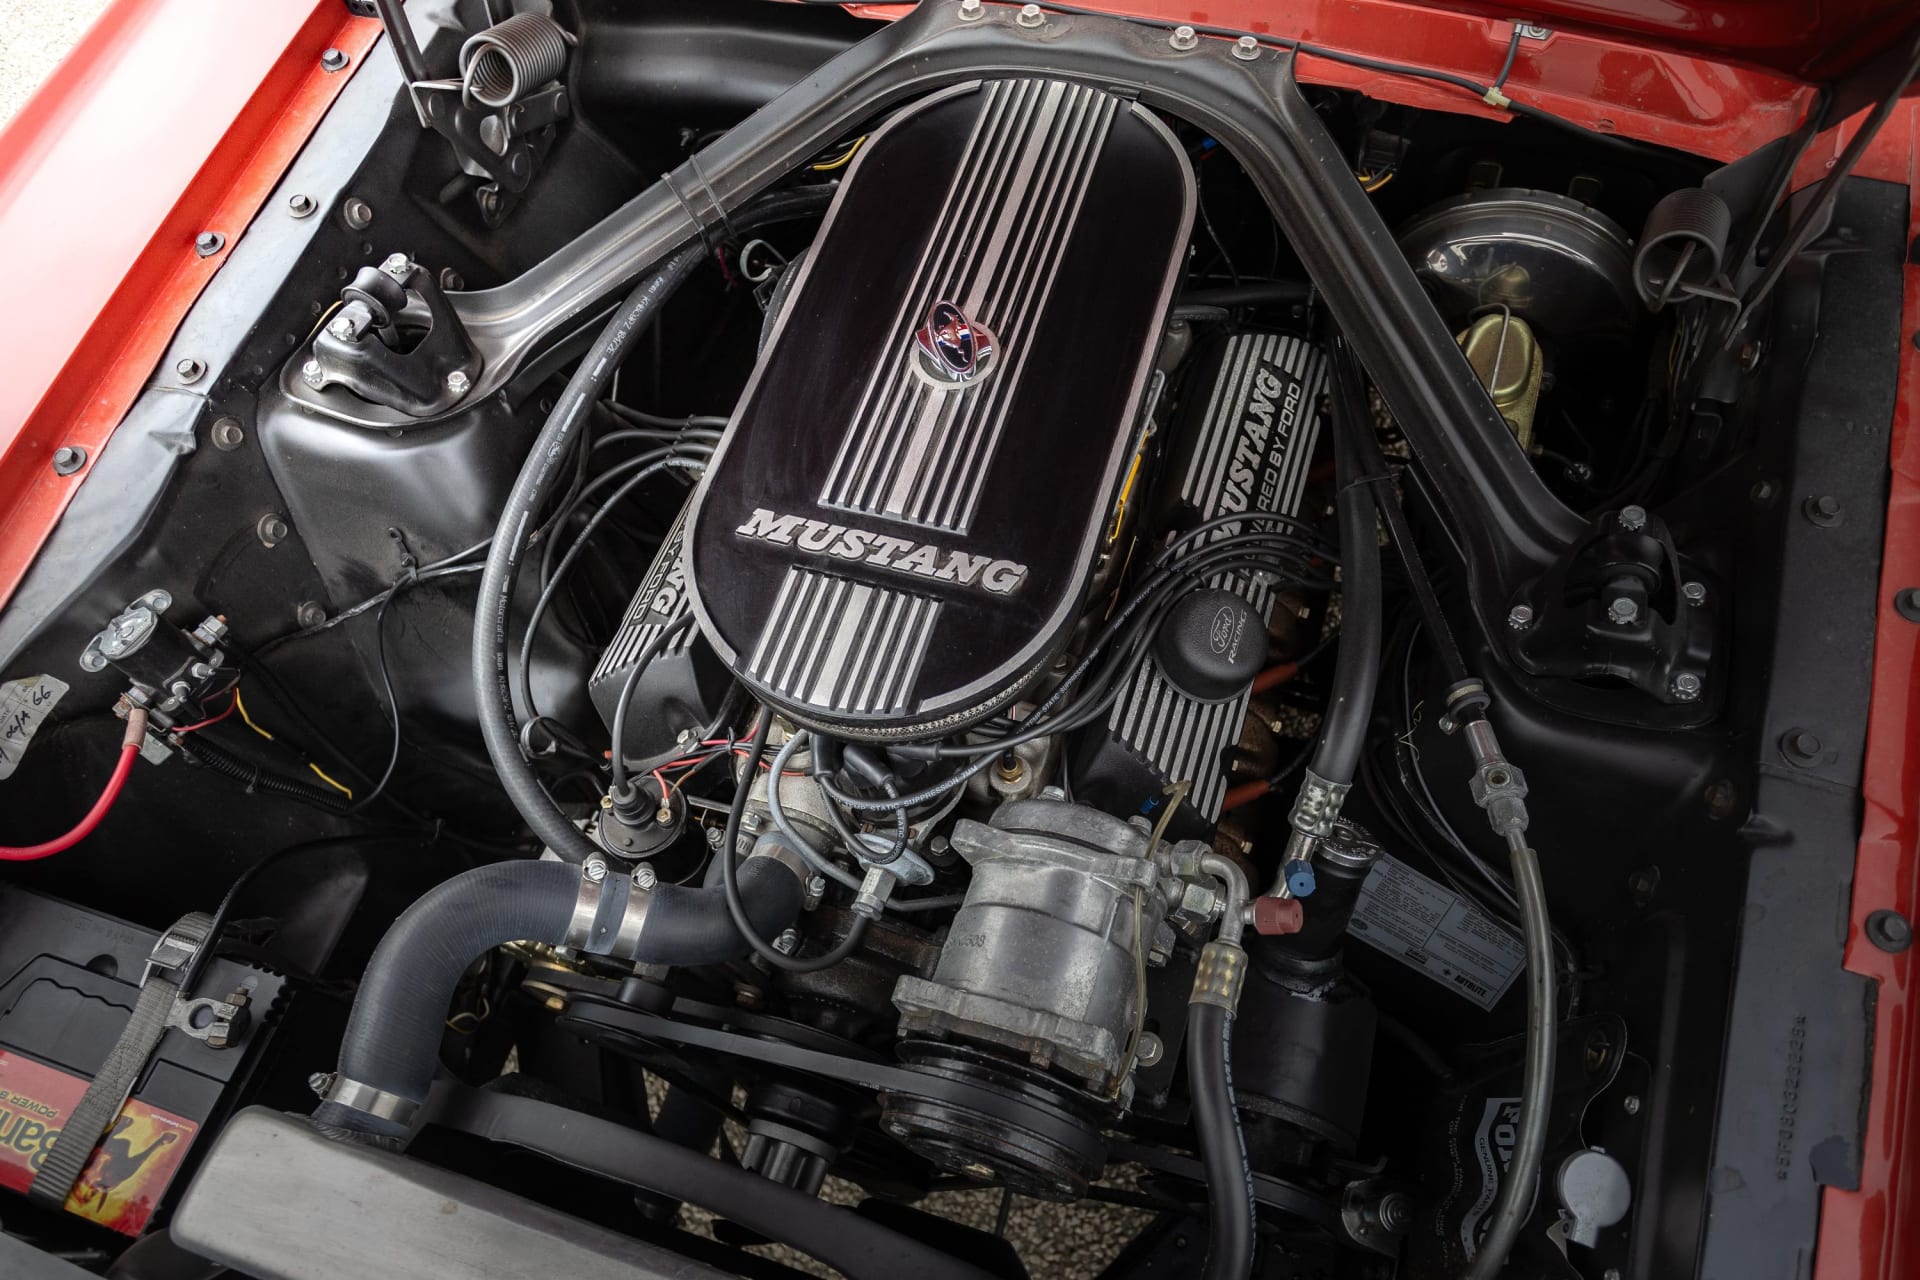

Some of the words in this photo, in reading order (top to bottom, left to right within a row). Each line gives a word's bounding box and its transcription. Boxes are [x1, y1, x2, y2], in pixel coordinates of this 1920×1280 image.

[1268, 435, 1285, 467] BY
[1277, 381, 1300, 437] FORD
[735, 508, 1028, 594] MUSTANG
[632, 561, 670, 620] FORD
[1212, 612, 1232, 648] Ford
[1227, 608, 1247, 665] RACING
[1042, 693, 1060, 713] STATIC
[870, 802, 898, 811] STATIC
[903, 778, 960, 806] SUPPRESSION
[1454, 975, 1488, 998] AUTOLITE
[10, 1096, 59, 1119] POWER
[1478, 1137, 1496, 1184] GENUINE
[1471, 1186, 1495, 1217] PARTS
